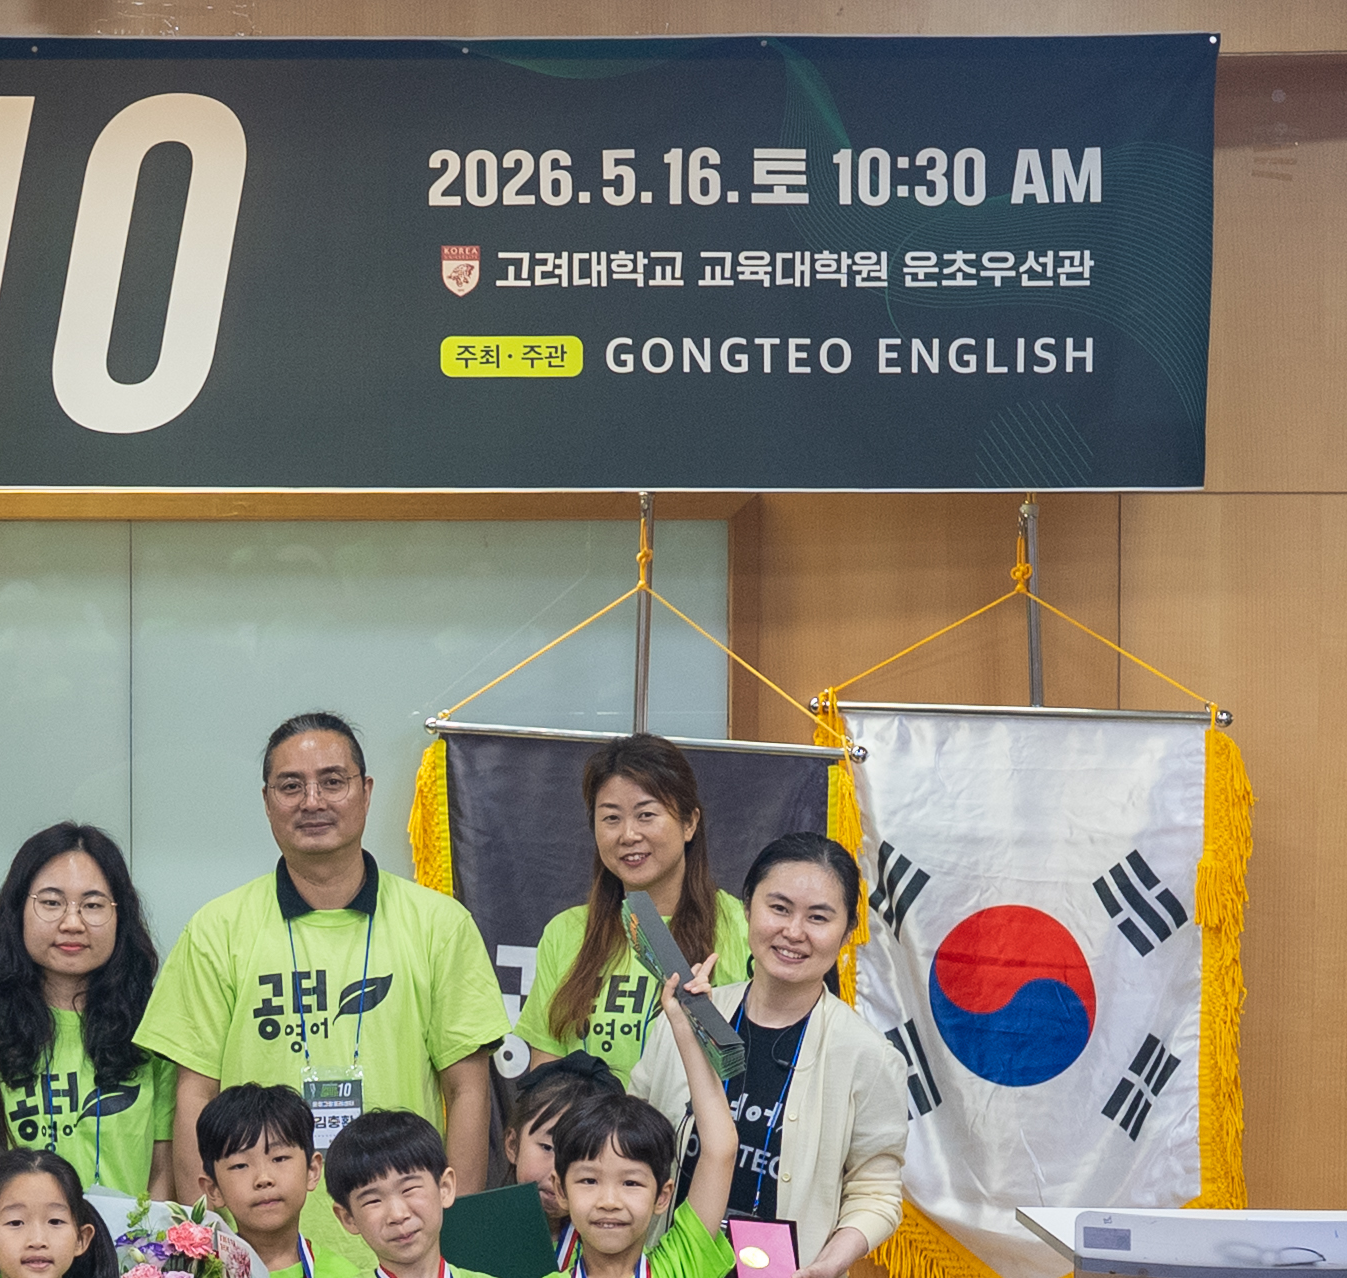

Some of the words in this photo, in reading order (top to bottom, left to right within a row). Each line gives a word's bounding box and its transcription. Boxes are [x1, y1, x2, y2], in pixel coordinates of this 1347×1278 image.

[832, 147, 986, 207] 10:30
[1010, 147, 1102, 205] AM
[495, 251, 684, 287] 고려대학교
[698, 251, 888, 287] 교육대학원
[902, 250, 1095, 288] 운초우선관
[605, 337, 852, 374] GONGTEO
[878, 337, 1094, 374] ENGLISH
[253, 970, 327, 1040] 공터
[285, 1017, 328, 1053] 영어
[593, 1019, 642, 1053] 영어
[9, 1072, 78, 1141] 공터
[338, 1082, 352, 1097] 10
